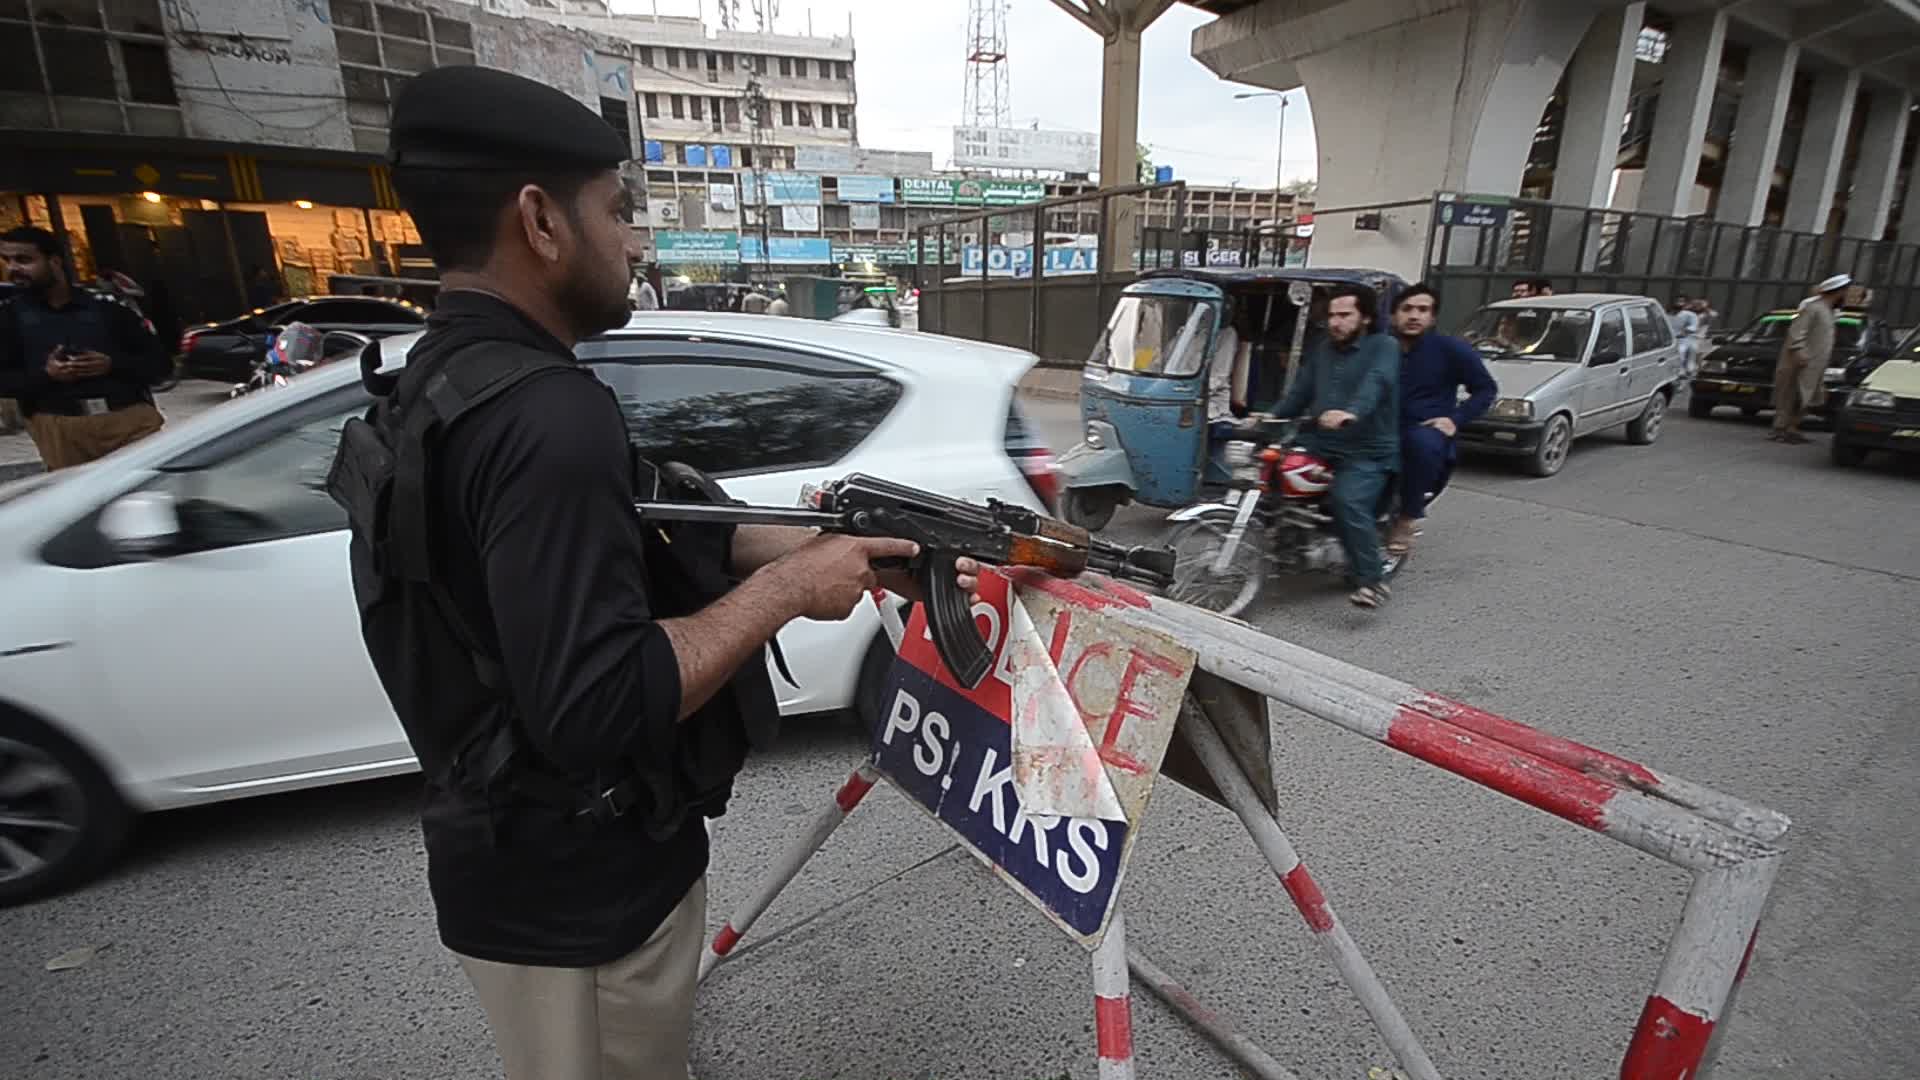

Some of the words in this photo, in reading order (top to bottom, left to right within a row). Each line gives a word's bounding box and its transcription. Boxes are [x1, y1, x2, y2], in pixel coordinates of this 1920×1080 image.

[903, 178, 953, 190] DENTAL
[967, 248, 1098, 270] POPLA
[1183, 250, 1241, 264] SIGER
[968, 747, 1109, 894] KRS
